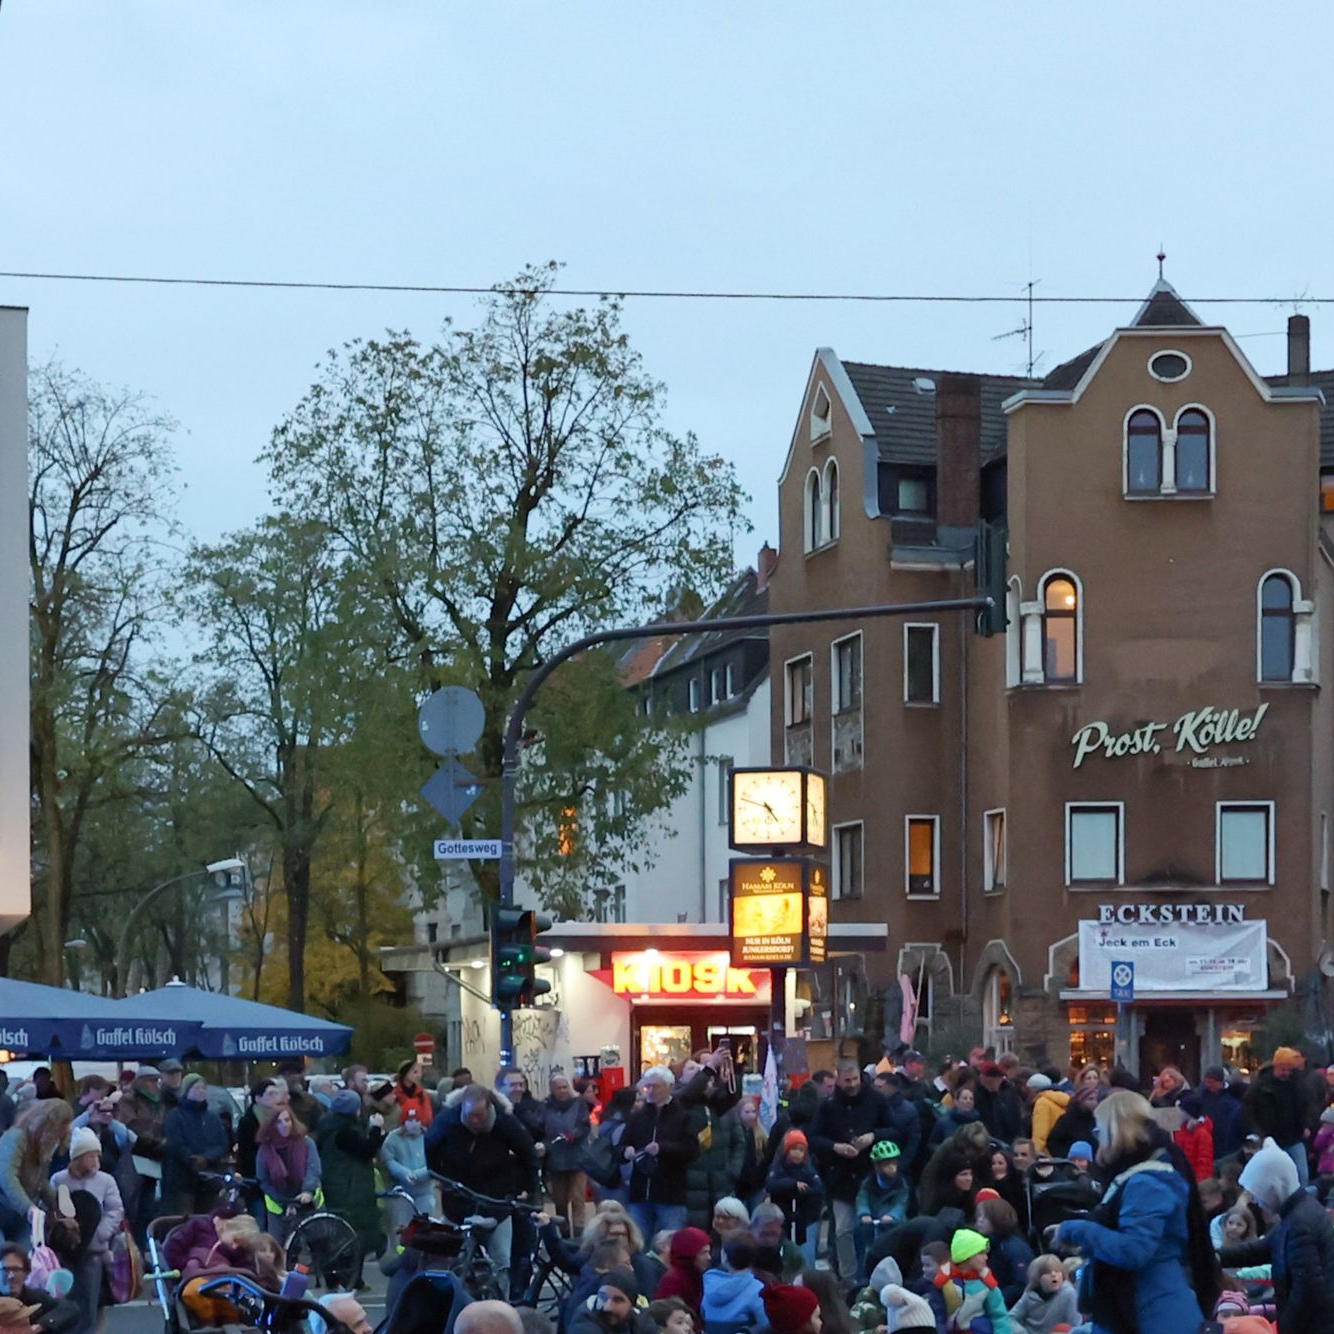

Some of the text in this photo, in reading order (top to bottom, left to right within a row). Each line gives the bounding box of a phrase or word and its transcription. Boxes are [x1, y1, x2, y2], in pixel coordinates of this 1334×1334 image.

[1072, 702, 1269, 768] Prost, Kölle!
[438, 843, 497, 855] Gottesweg
[1099, 904, 1245, 925] ECKSTEIN
[1099, 938, 1176, 947] Jeck em Eck
[614, 959, 756, 994] KIOSK
[97, 1027, 176, 1045] Gaffel Kölsch
[239, 1036, 324, 1052] Gaffel Kölsch
